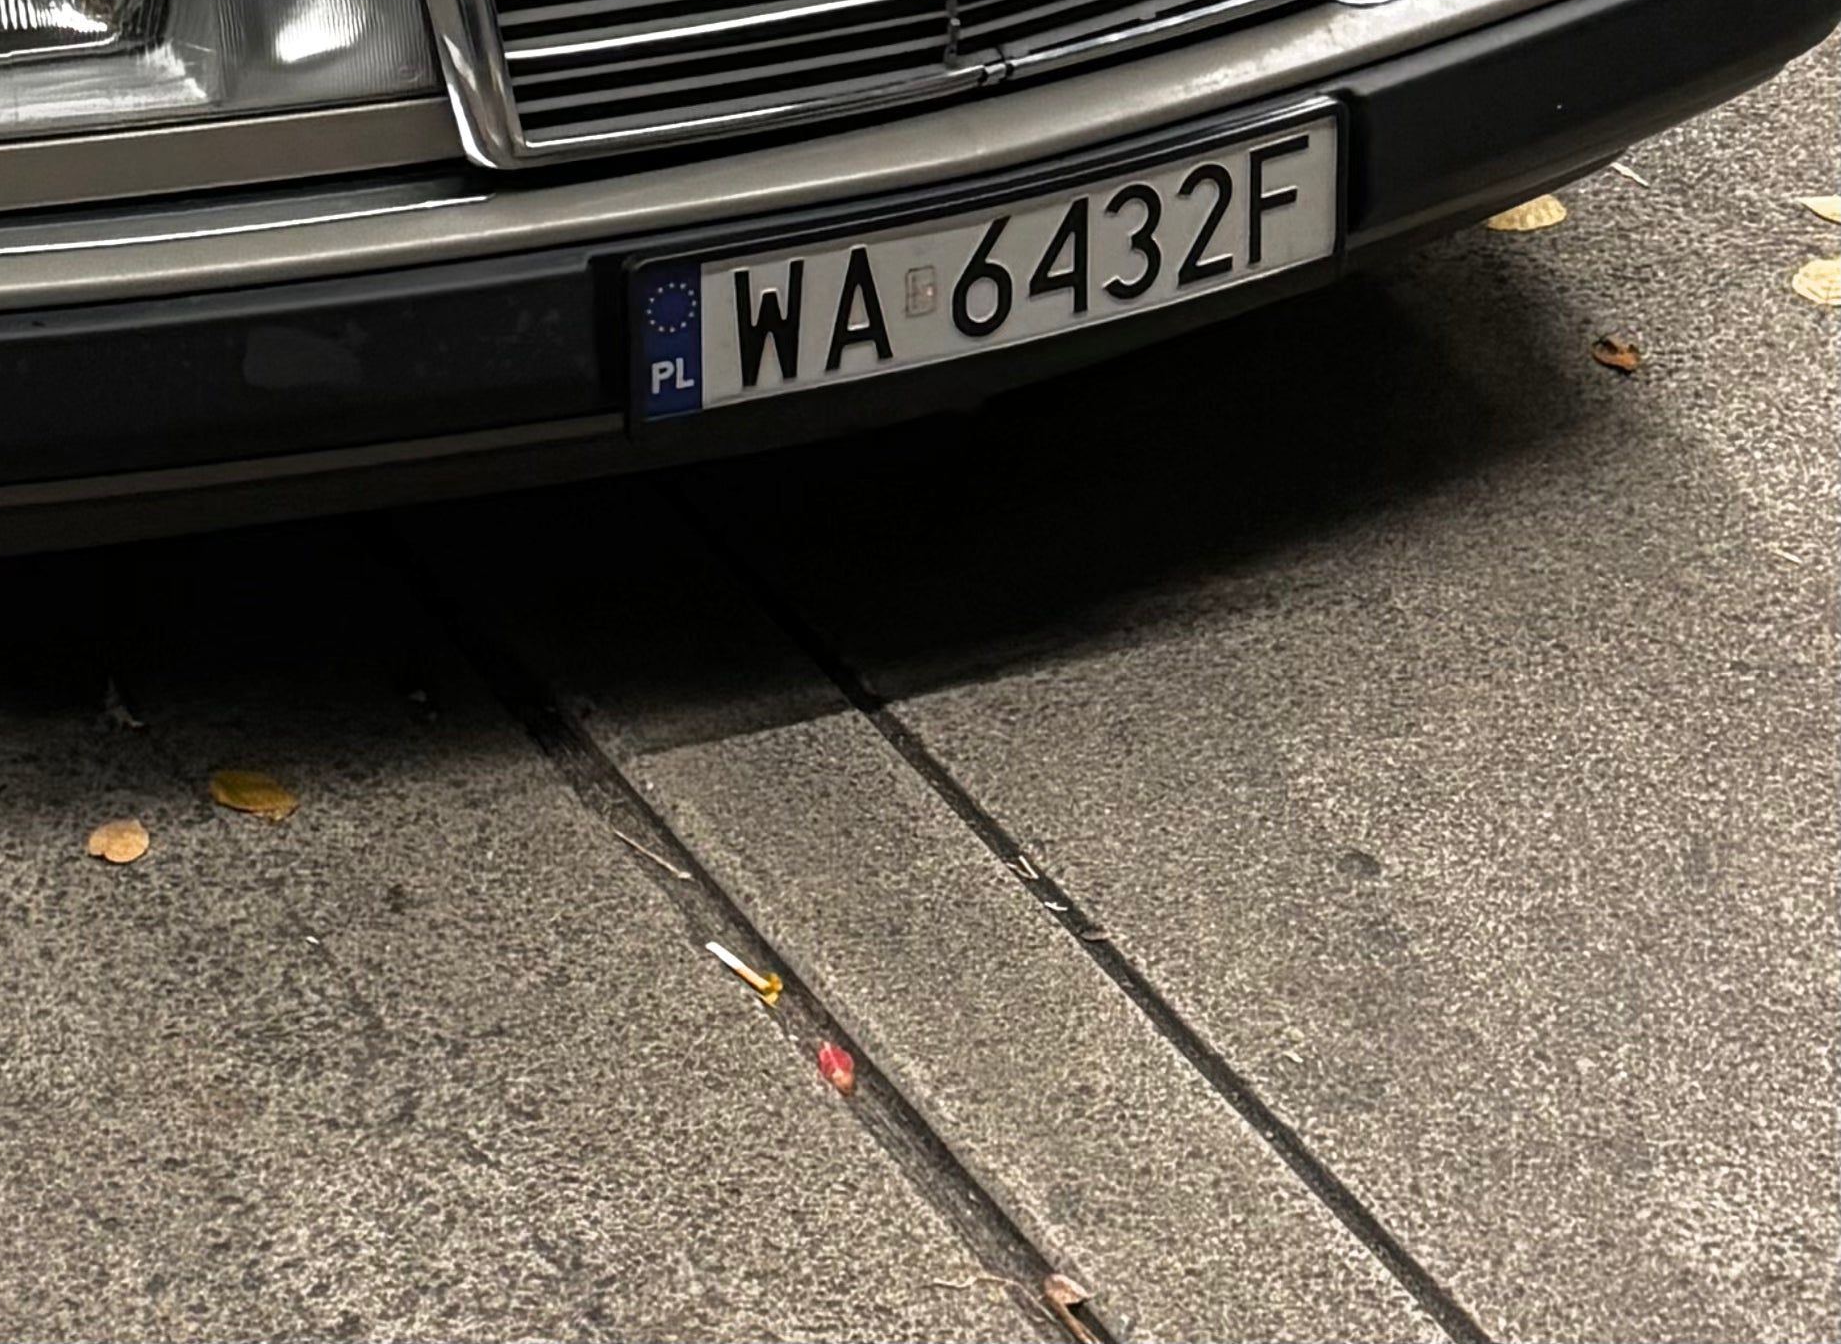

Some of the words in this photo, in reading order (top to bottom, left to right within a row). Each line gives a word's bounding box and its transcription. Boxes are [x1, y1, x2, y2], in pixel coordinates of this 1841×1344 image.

[733, 245, 894, 389] WA
[950, 134, 1311, 338] 6432F
[650, 358, 695, 396] PL
